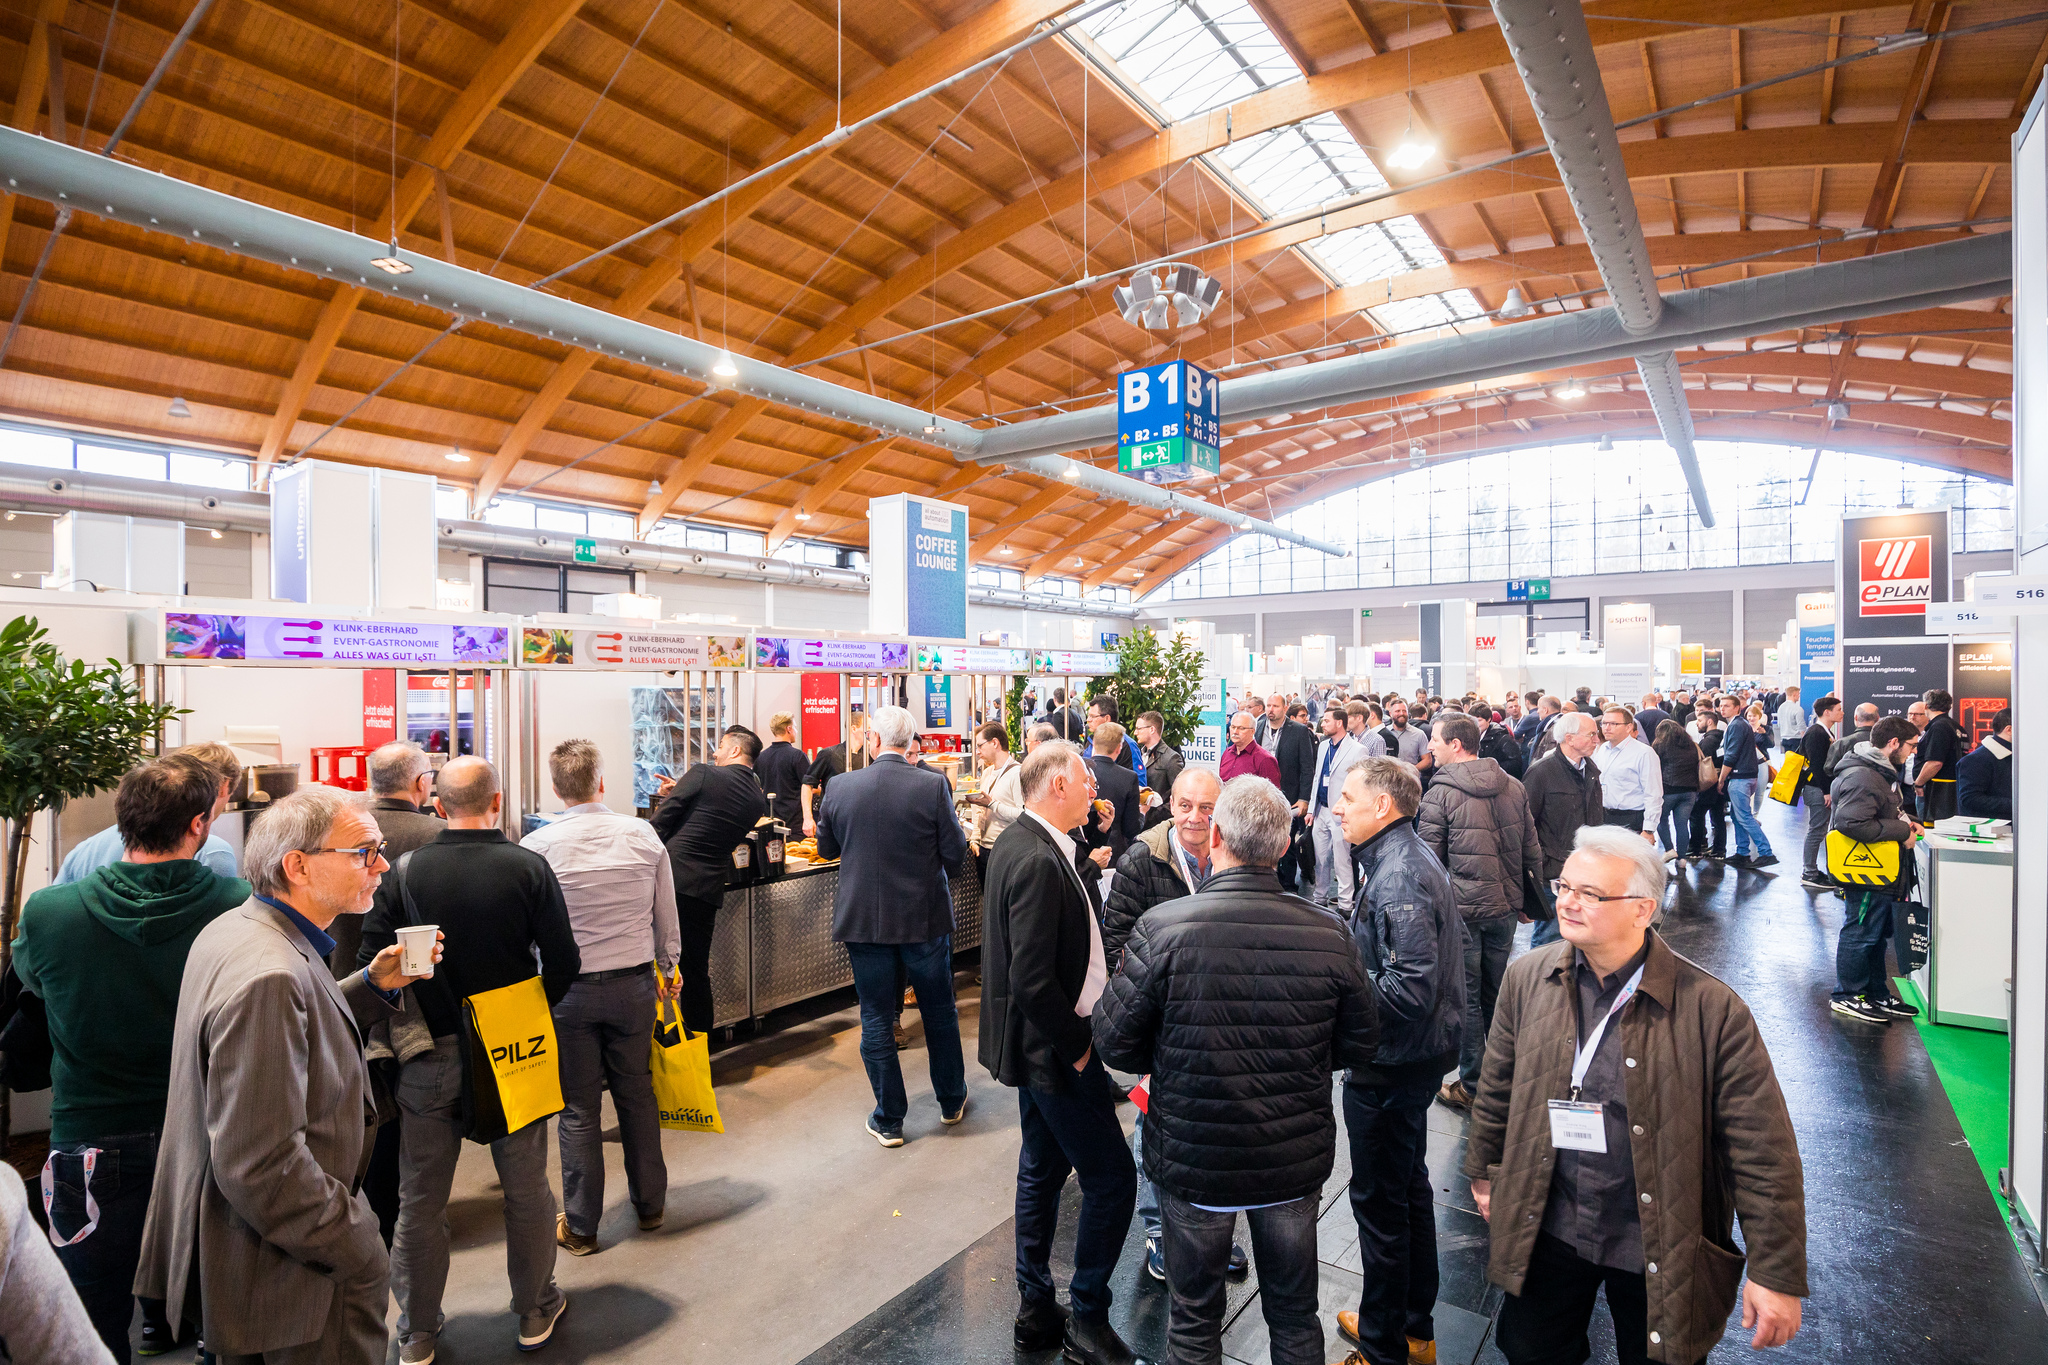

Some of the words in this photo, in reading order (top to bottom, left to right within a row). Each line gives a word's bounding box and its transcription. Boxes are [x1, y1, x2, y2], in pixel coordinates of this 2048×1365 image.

[1193, 414, 1202, 428] B2
[1208, 420, 1218, 434] B5
[1135, 429, 1150, 442] B2
[1162, 423, 1178, 437] B5
[1193, 428, 1202, 440] A1
[1208, 434, 1218, 446] A7
[925, 514, 949, 524] automation
[916, 534, 957, 555] COFFEE
[916, 552, 957, 572] LOUNGE
[1512, 582, 1525, 590] B1
[2016, 589, 2045, 599] 516
[1615, 616, 1647, 624] spectra
[334, 624, 418, 634] KLINK-EBERHARD
[334, 638, 439, 648] EVENT-GASTRONOMIE
[629, 635, 685, 644] KLINK-EBERHARD
[1476, 636, 1496, 646] EW
[629, 646, 699, 654] EVENT-GASTRONOMIE
[818, 697, 837, 705] eiskalt
[364, 705, 376, 715] Jetzt
[377, 705, 394, 716] eiskalt
[366, 717, 392, 728] erfrischen!
[1181, 750, 1216, 761] OUNGE
[490, 1034, 547, 1069] PILZ
[529, 1060, 546, 1069] SAFETY
[660, 1111, 713, 1123] Bürklin
